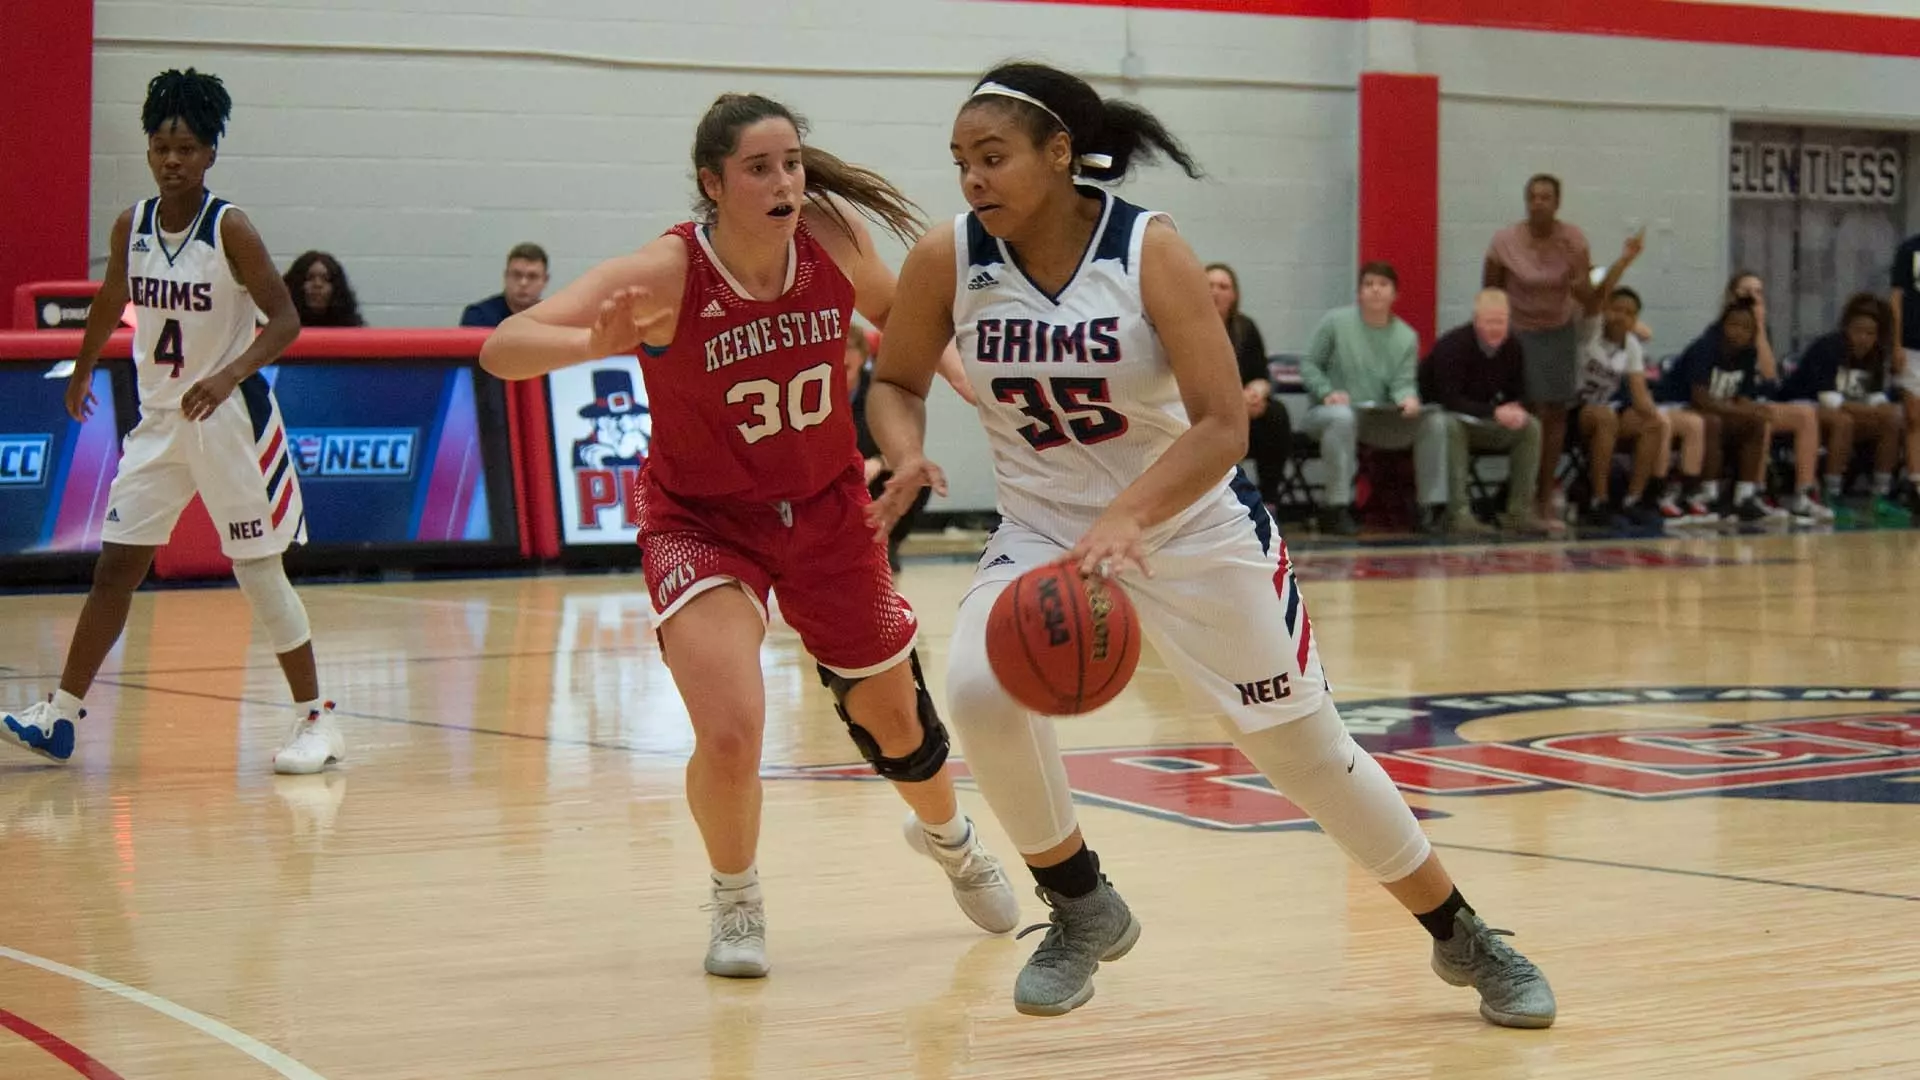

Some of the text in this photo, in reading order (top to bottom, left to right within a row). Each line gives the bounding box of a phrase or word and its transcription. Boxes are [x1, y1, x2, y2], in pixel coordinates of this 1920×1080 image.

[131, 276, 213, 312] GRIMS
[153, 318, 185, 379] 4
[704, 308, 842, 373] KEENE STATE
[976, 316, 1122, 363] GRIMS
[726, 362, 833, 444] 30
[991, 376, 1129, 452] 35
[326, 438, 410, 470] NECC
[229, 518, 263, 541] NEC
[658, 561, 697, 607] OWLS
[1234, 672, 1291, 706] NEC
